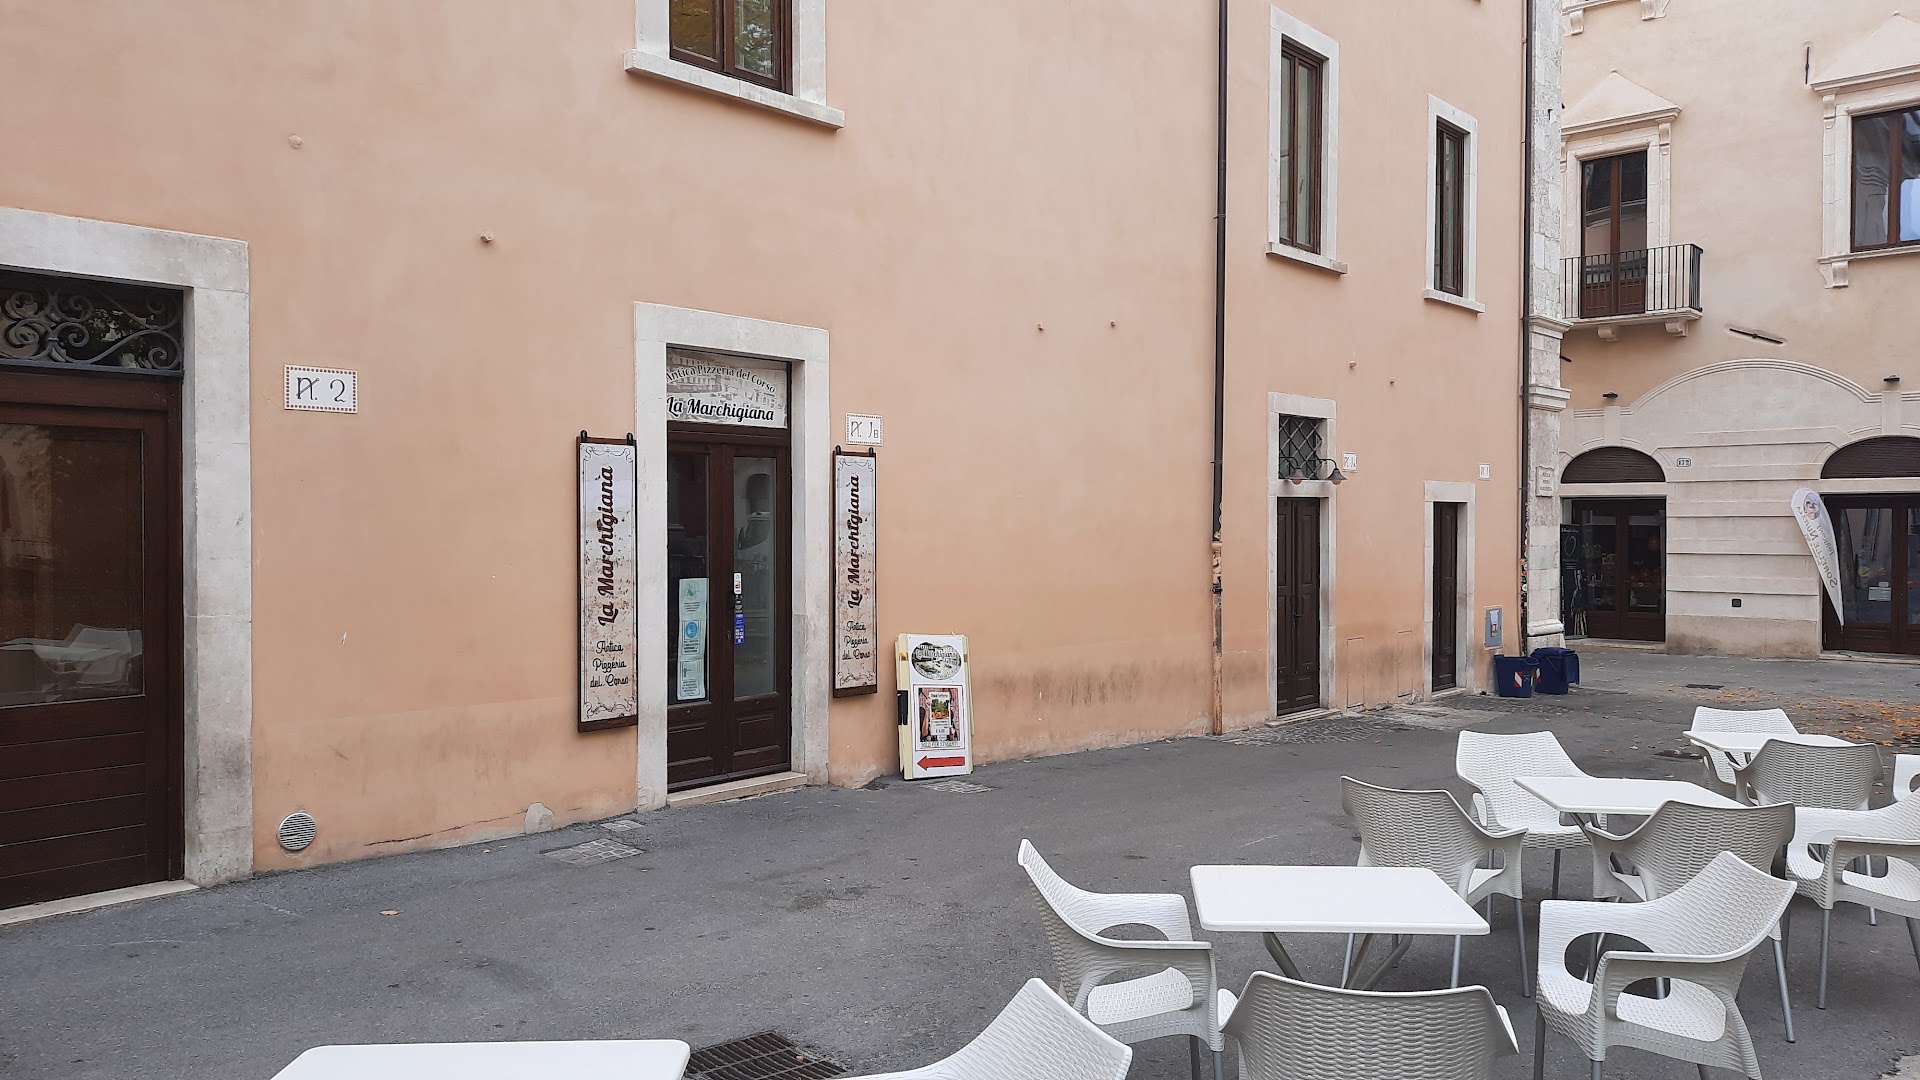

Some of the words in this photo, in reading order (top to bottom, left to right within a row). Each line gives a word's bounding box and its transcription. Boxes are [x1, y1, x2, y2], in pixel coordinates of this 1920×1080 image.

[329, 378, 347, 403] 2
[666, 366, 696, 383] Antica
[697, 364, 734, 377] Pizzeria
[736, 368, 751, 381] del
[751, 374, 776, 394] Corso
[666, 396, 683, 418] La
[687, 398, 775, 423] Marchigiana
[595, 465, 619, 596] Marchigiana
[845, 474, 864, 585] Marchigiana
[847, 590, 863, 610] La
[597, 602, 619, 627] La
[596, 640, 624, 654] Antica
[592, 657, 627, 673] Pizzeria
[589, 675, 602, 688] del
[605, 673, 629, 687] Corso
